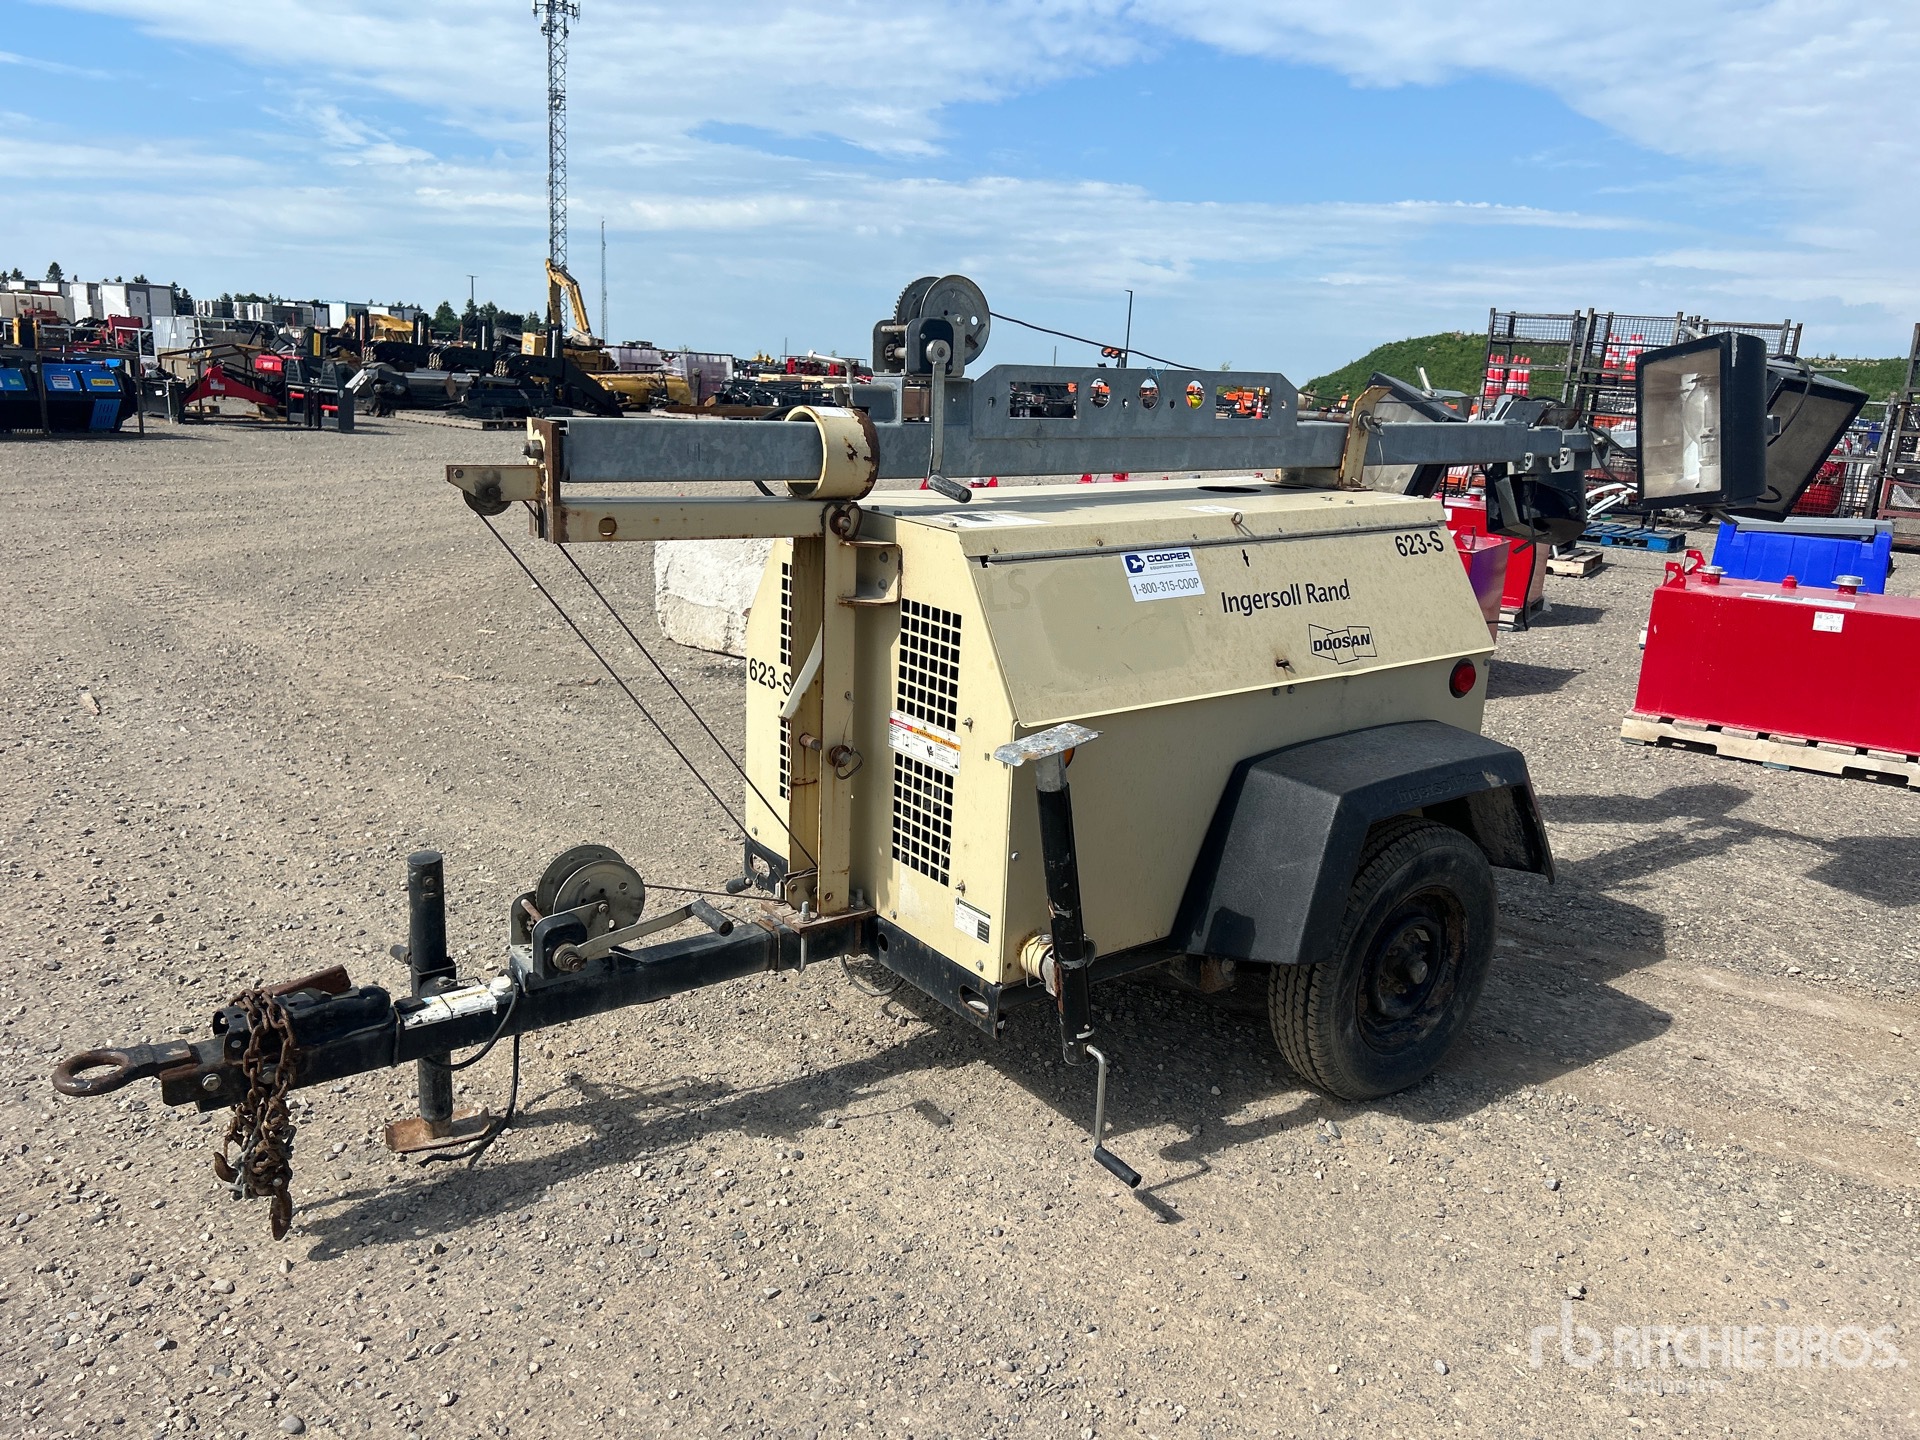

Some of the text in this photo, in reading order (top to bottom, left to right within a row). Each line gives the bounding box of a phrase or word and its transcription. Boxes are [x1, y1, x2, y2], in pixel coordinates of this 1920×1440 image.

[1395, 530, 1445, 557] 623-S
[1147, 552, 1191, 562] COOPER
[1133, 577, 1199, 595] 1-800-315-COOP
[1221, 578, 1351, 617] Ingersoll Rand
[1312, 633, 1371, 654] DOOSAN
[749, 657, 792, 697] 623-S
